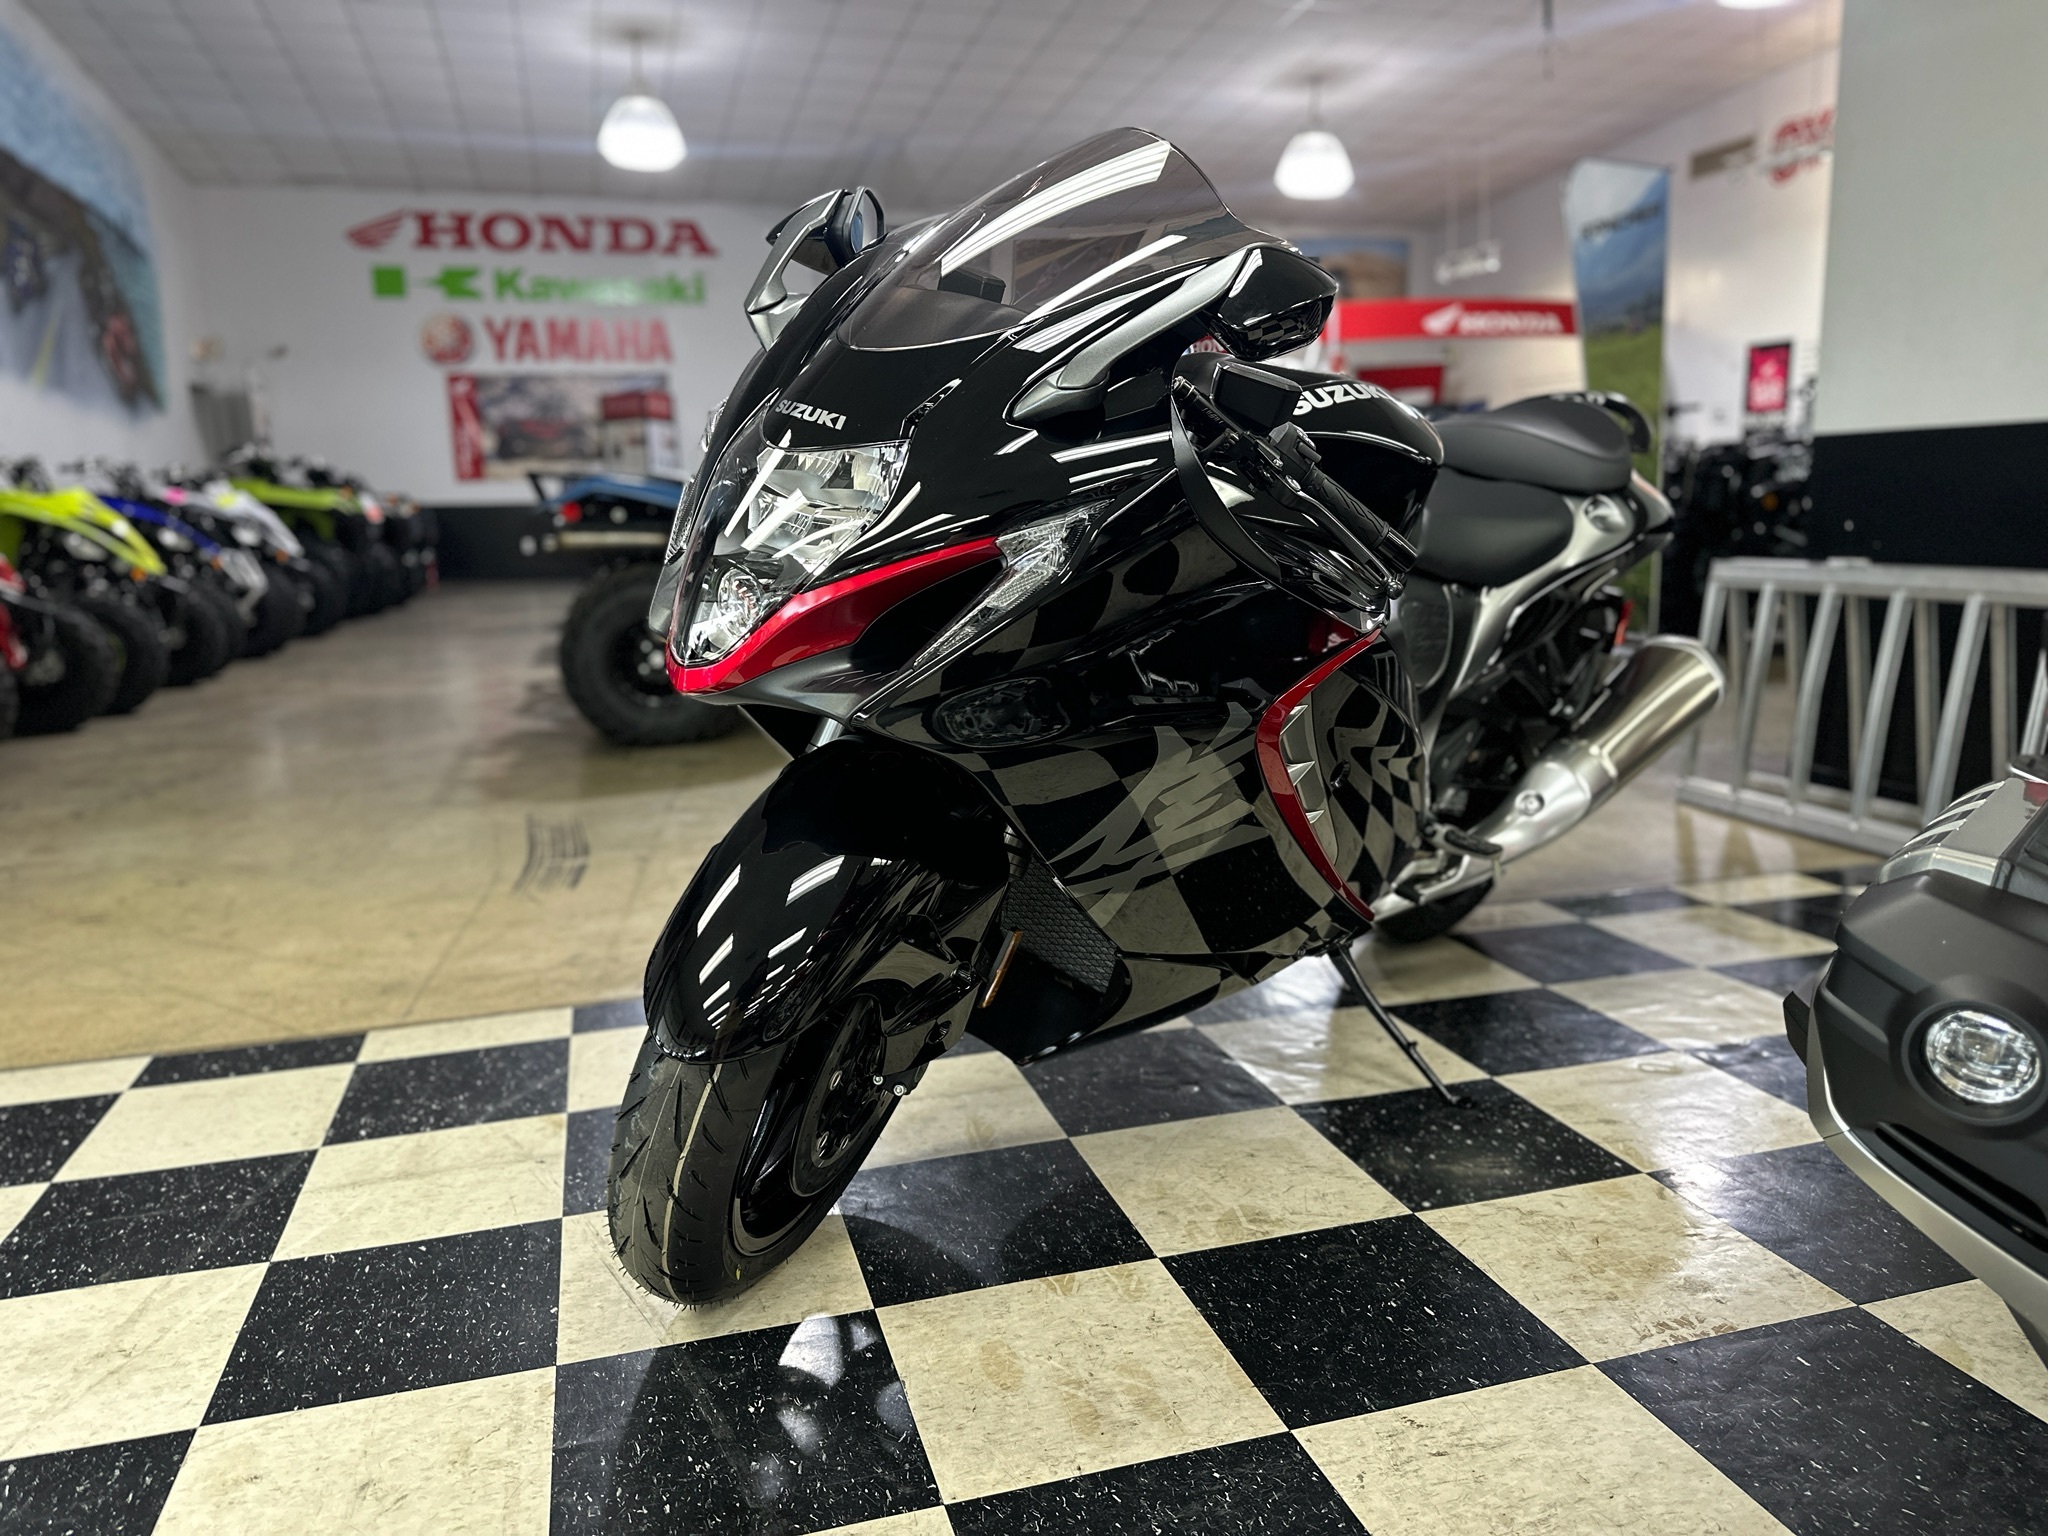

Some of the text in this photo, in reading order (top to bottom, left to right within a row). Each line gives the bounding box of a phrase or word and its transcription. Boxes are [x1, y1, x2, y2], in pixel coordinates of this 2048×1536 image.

[412, 210, 717, 255] HONDA
[493, 267, 706, 305] Kawasaki
[482, 315, 674, 363] YAMAHA
[775, 399, 847, 431] SUZUKI
